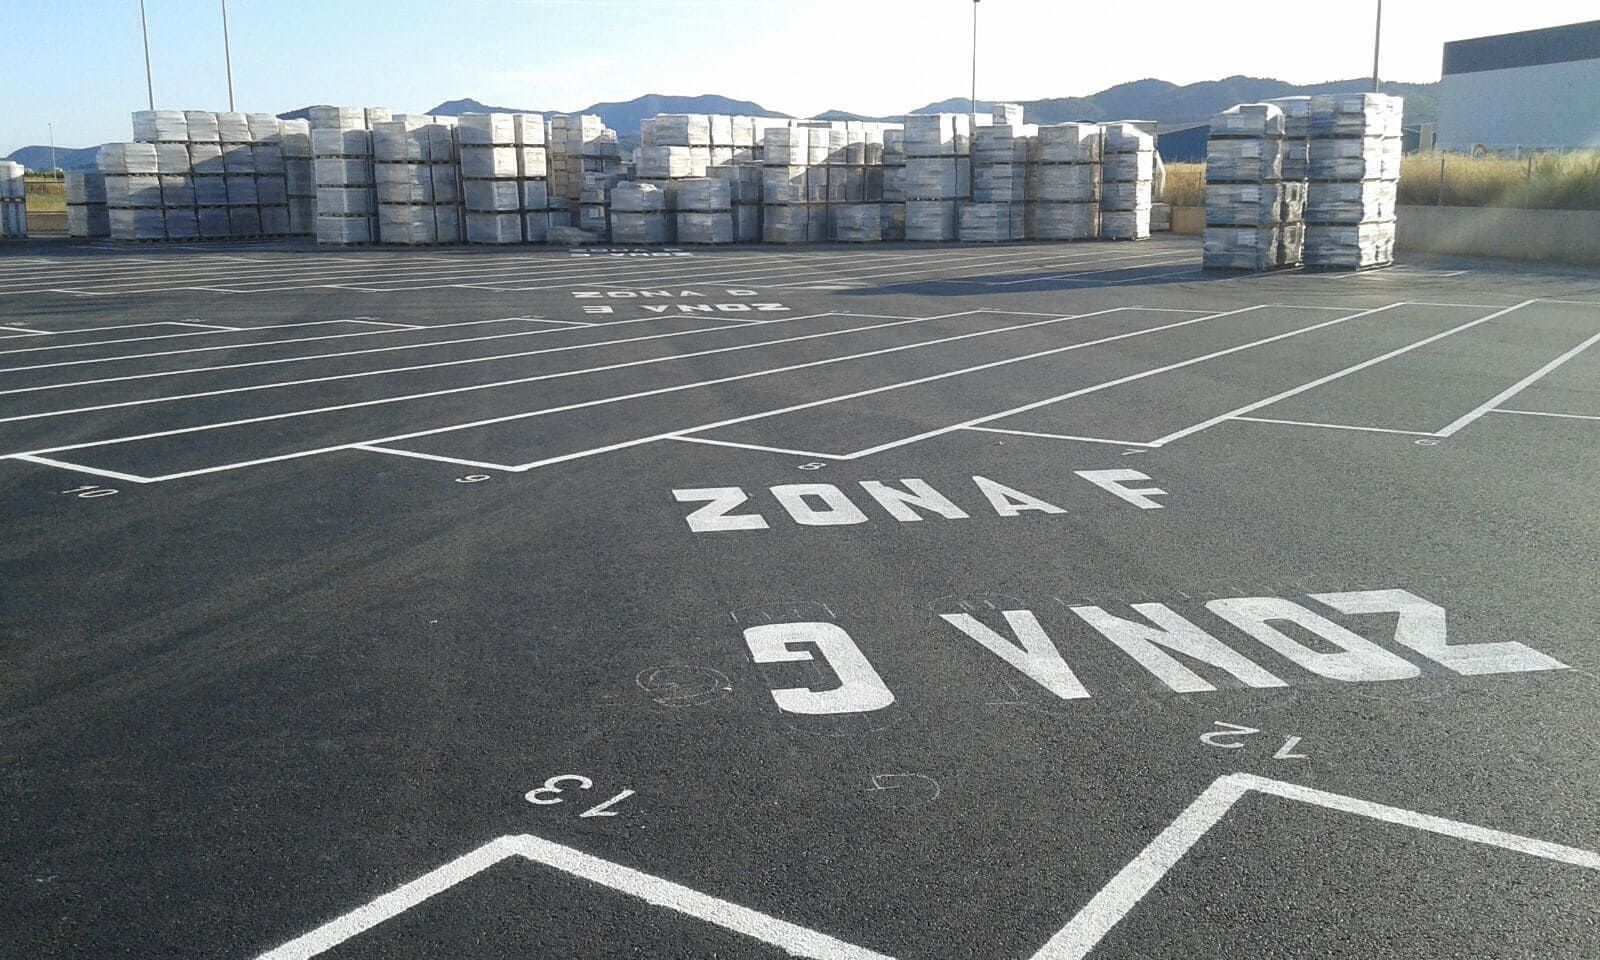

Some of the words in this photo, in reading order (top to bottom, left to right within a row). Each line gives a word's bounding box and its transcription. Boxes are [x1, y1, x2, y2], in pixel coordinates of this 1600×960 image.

[571, 289, 707, 299] ZONA
[725, 288, 759, 297] D
[581, 304, 614, 314] E
[640, 302, 791, 314] ZONA
[797, 462, 827, 471] 8
[455, 474, 491, 483] 9
[61, 485, 119, 499] 10
[671, 475, 1069, 533] ZONA
[1072, 468, 1169, 510] F
[939, 588, 1572, 701] ZONA
[743, 621, 896, 716] G
[1199, 720, 1309, 760] 12
[524, 774, 637, 818] 13
